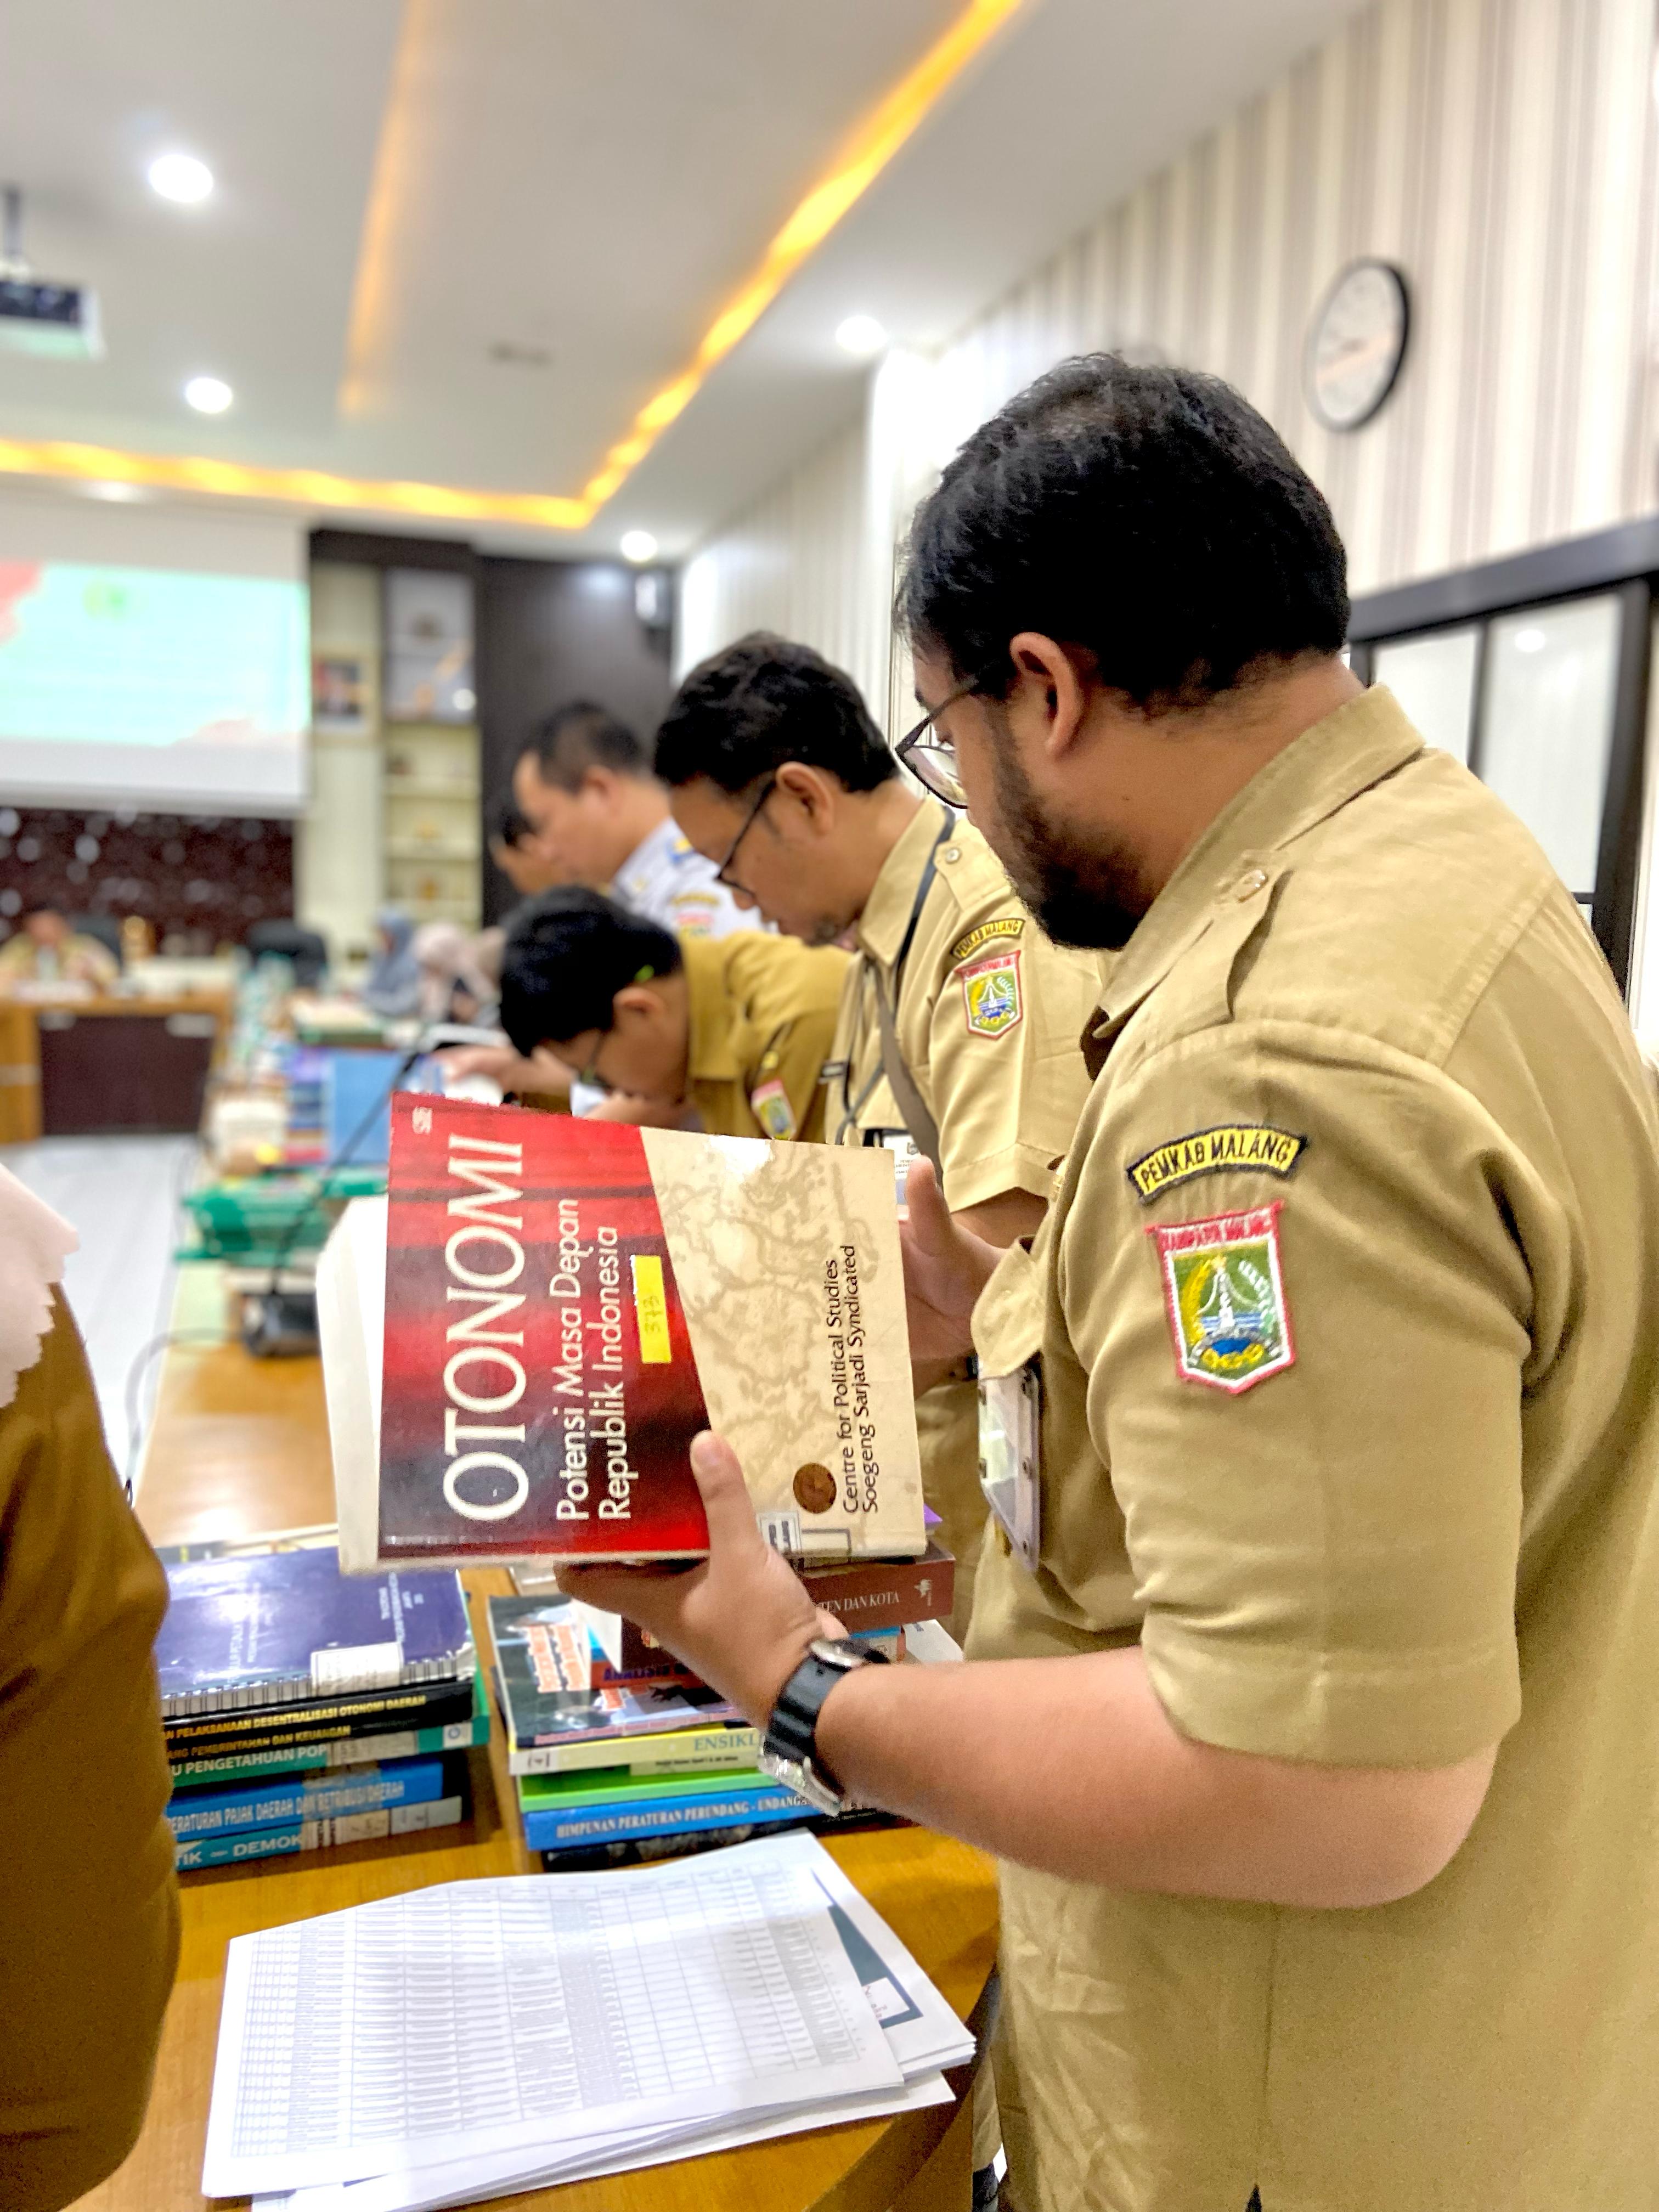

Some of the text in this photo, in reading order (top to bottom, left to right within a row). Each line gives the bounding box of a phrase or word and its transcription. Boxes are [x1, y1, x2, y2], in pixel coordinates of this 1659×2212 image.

[985, 921, 1019, 935] MALANG
[1140, 1131, 1291, 1192] PEMKAB MALANG
[443, 1132, 529, 1521] OTONOMI
[549, 1199, 593, 1521] Potensi Masa Depan
[586, 1226, 639, 1521] Republik Indonesia
[840, 1245, 879, 1514] Soegeng Sarjadi Syndicated
[826, 1259, 859, 1514] Centre for Political Studies
[844, 1596, 869, 1612] DAN
[870, 1590, 900, 1607] KOTA
[176, 1719, 252, 1739] PELAKSANAAN
[253, 1707, 337, 1728] DESENTRALISASI
[339, 1700, 385, 1716] OTONOMI
[386, 1695, 427, 1710] DAERAH
[272, 1733, 294, 1746] DAN
[295, 1725, 351, 1742] KEUANGAN
[185, 1748, 294, 1774] PENGETAHUAN
[297, 1743, 328, 1758] POP
[224, 1805, 254, 1826] PAJAK
[256, 1798, 294, 1821] DAERAH
[557, 1816, 617, 1839] HIMPUNAN
[618, 1810, 682, 1830] PERATURAN
[684, 1801, 749, 1822] PERUNDANG
